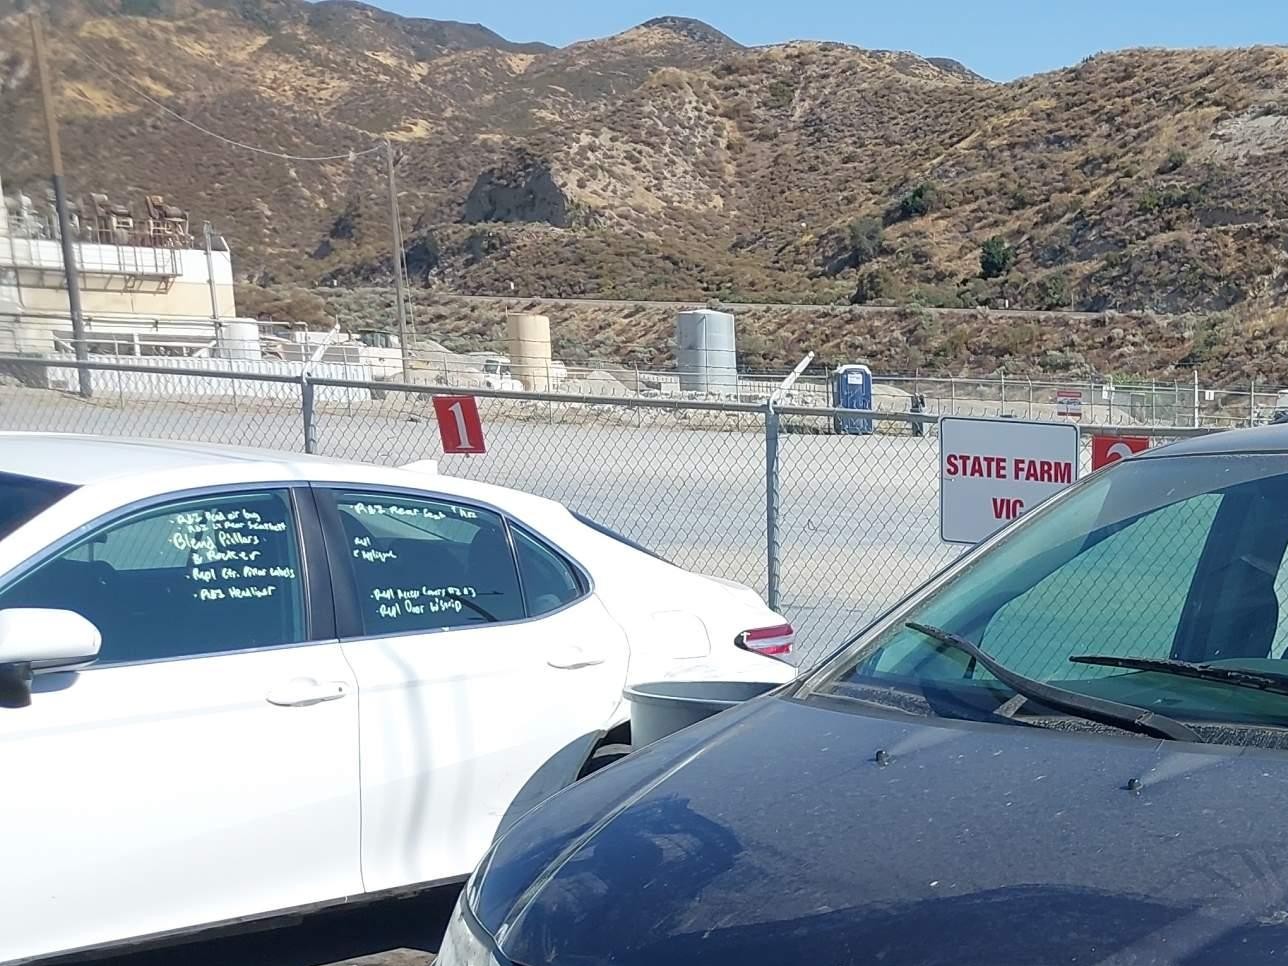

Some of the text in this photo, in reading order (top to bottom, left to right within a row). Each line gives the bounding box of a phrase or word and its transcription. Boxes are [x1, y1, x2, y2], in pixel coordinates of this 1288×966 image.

[448, 401, 475, 449] 1
[946, 454, 1072, 484] STATE FARM
[992, 498, 1024, 520] VIC
[172, 532, 217, 551] Blend
